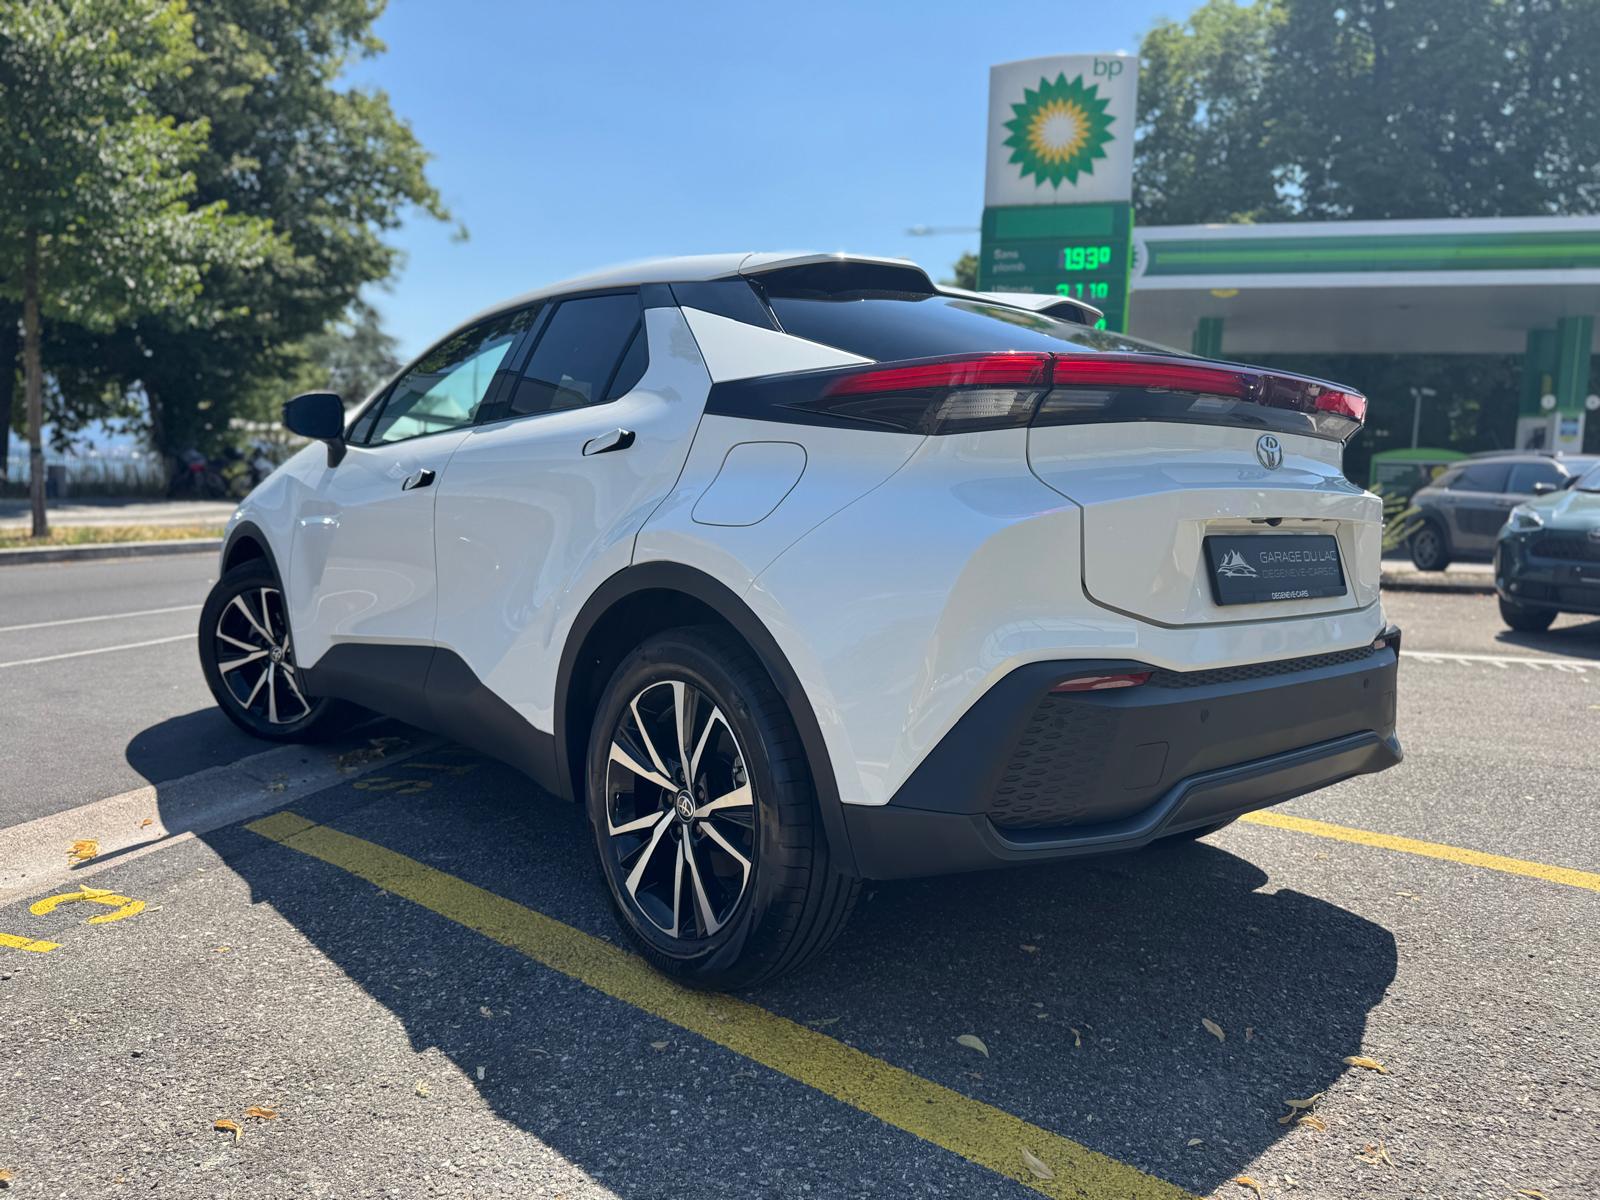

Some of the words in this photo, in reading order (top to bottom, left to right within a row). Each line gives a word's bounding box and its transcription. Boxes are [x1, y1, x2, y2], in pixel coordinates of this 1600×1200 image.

[1093, 56, 1123, 80] bp
[994, 249, 1018, 259] Sans
[1259, 552, 1302, 563] GARAGE
[1303, 551, 1318, 562] DU
[1318, 550, 1337, 562] LAC
